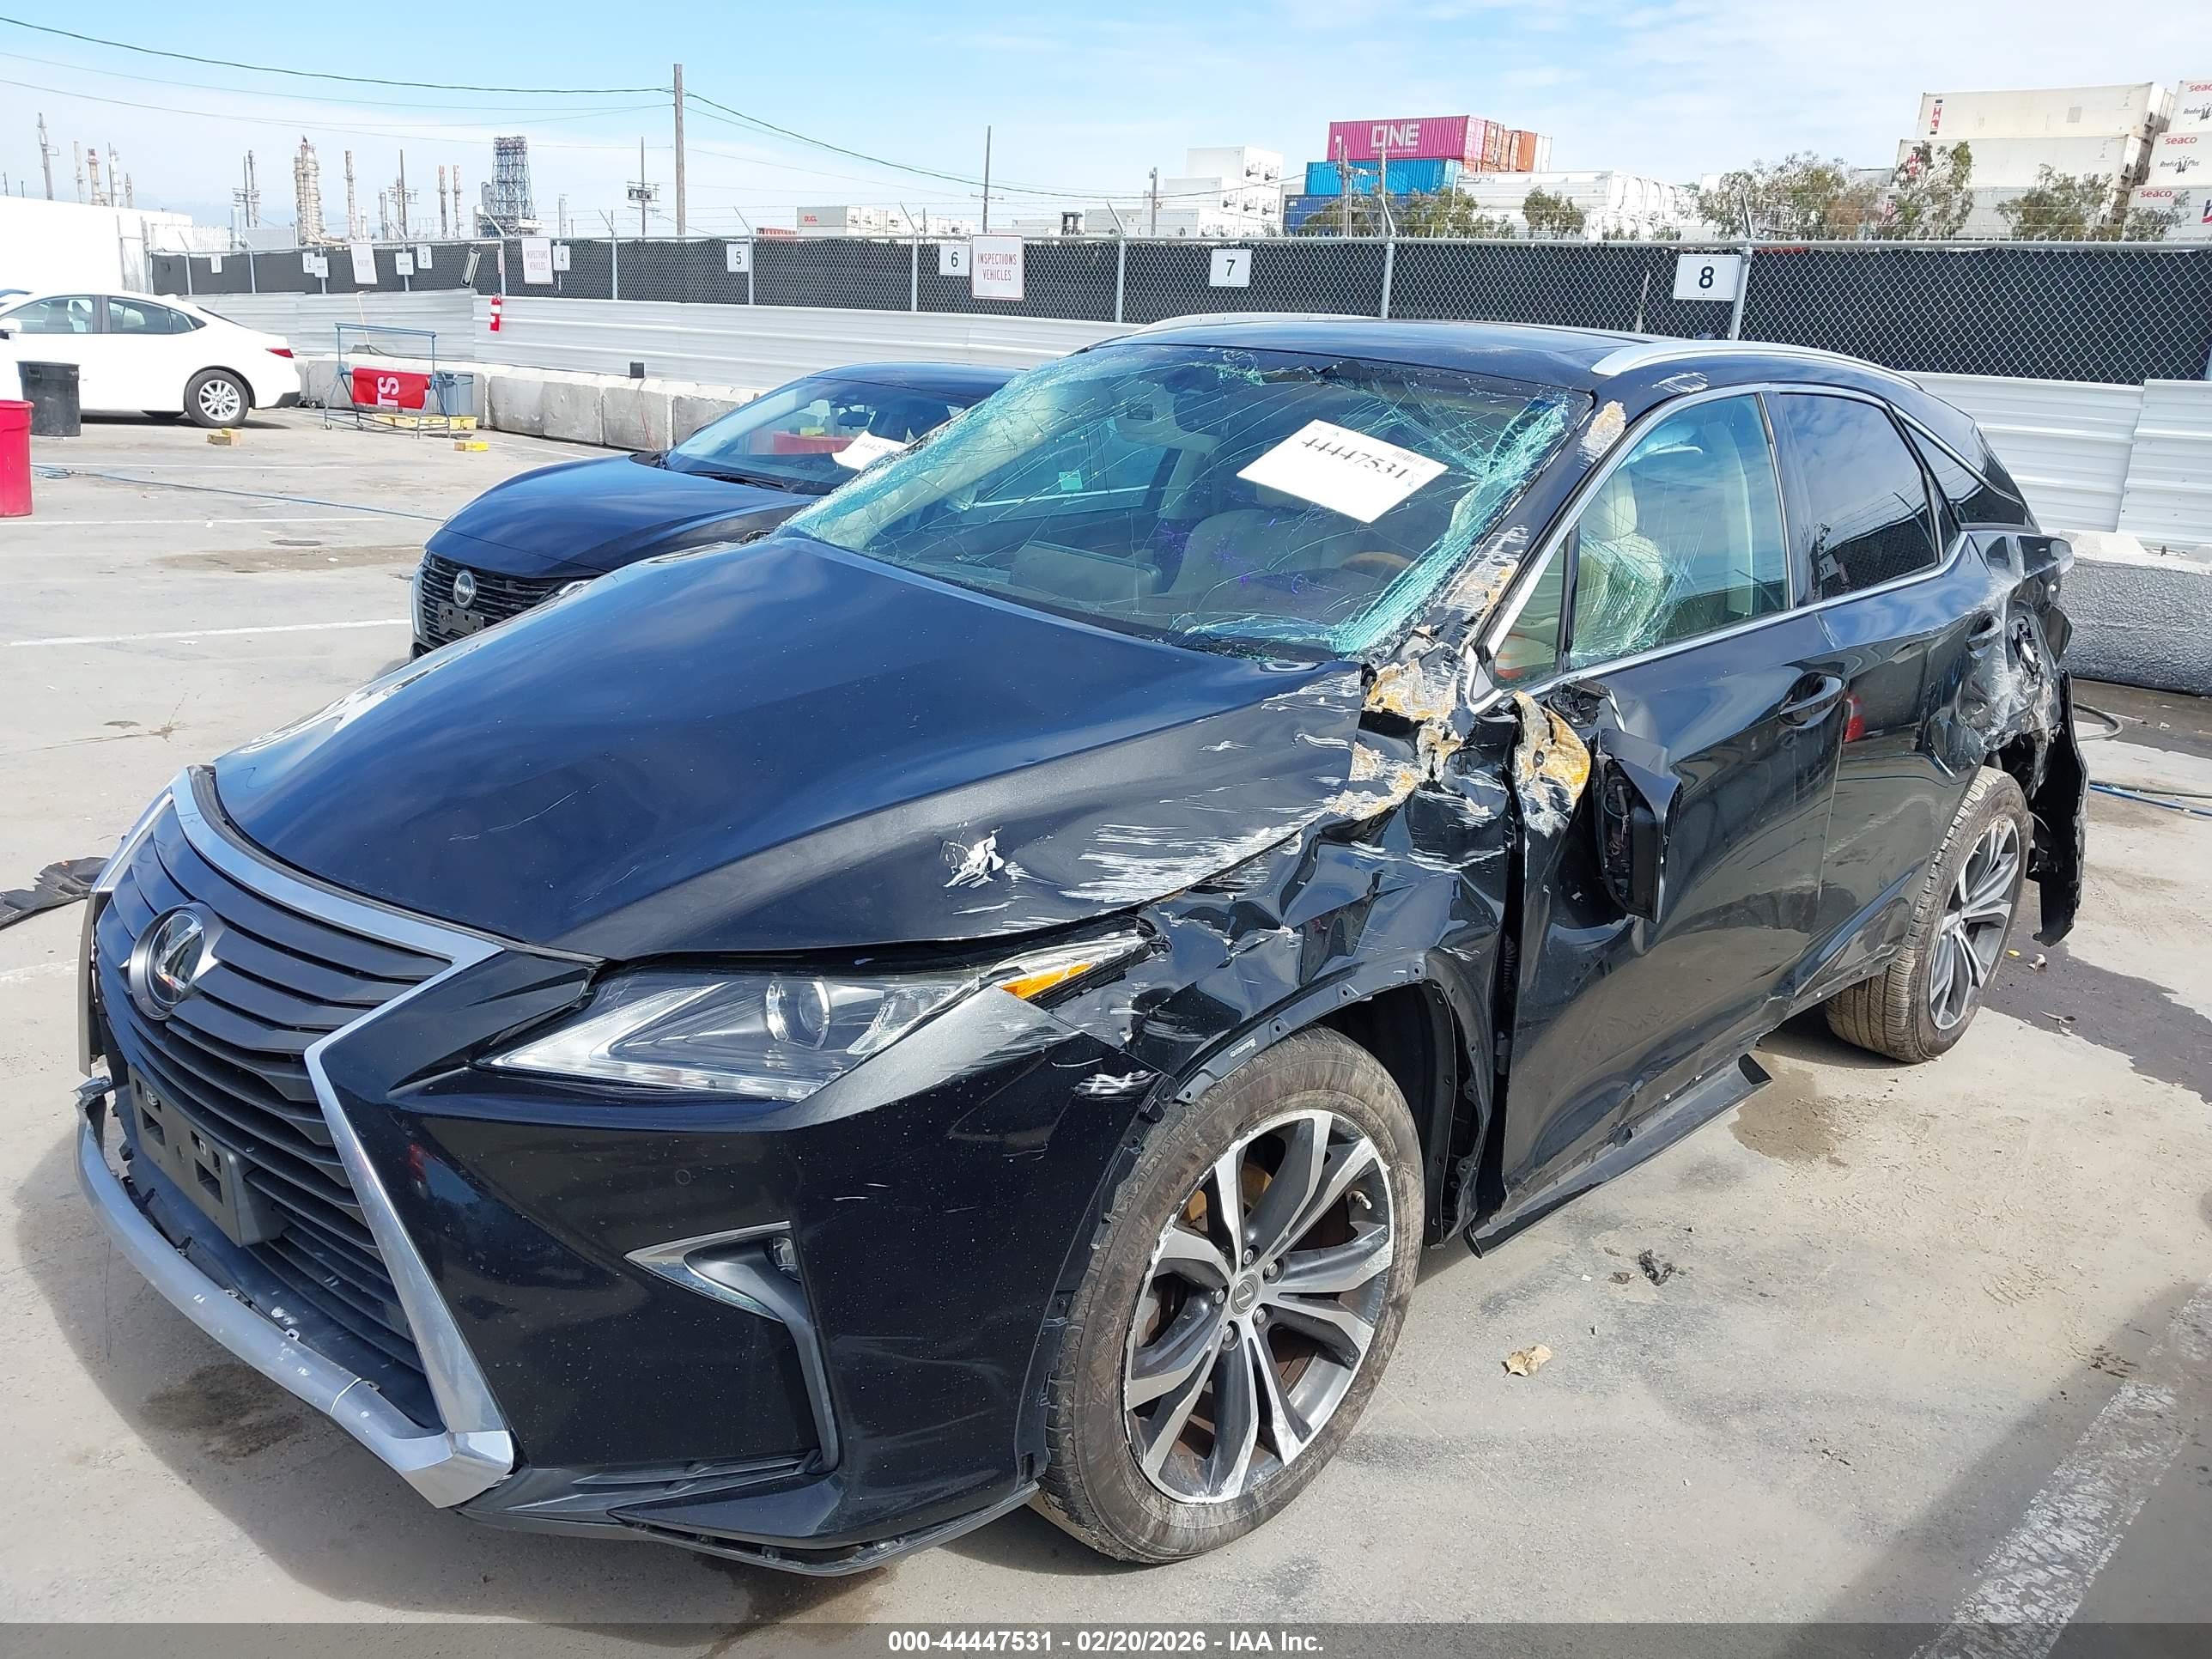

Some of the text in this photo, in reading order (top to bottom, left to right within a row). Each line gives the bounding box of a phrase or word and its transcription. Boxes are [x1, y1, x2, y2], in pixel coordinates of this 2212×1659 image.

[2189, 84, 2212, 93] seac
[1370, 123, 1419, 148] ONE
[2164, 136, 2197, 145] seaco
[2140, 190, 2172, 198] seaco
[560, 252, 565, 264] 4
[736, 251, 742, 265] 5
[951, 252, 959, 268] 6
[977, 252, 1017, 265] INSPECTIONS
[1226, 259, 1237, 276] 7
[982, 269, 1012, 281] VEHICLES
[1698, 265, 1715, 289] 8
[1301, 438, 1409, 479] 44447531
